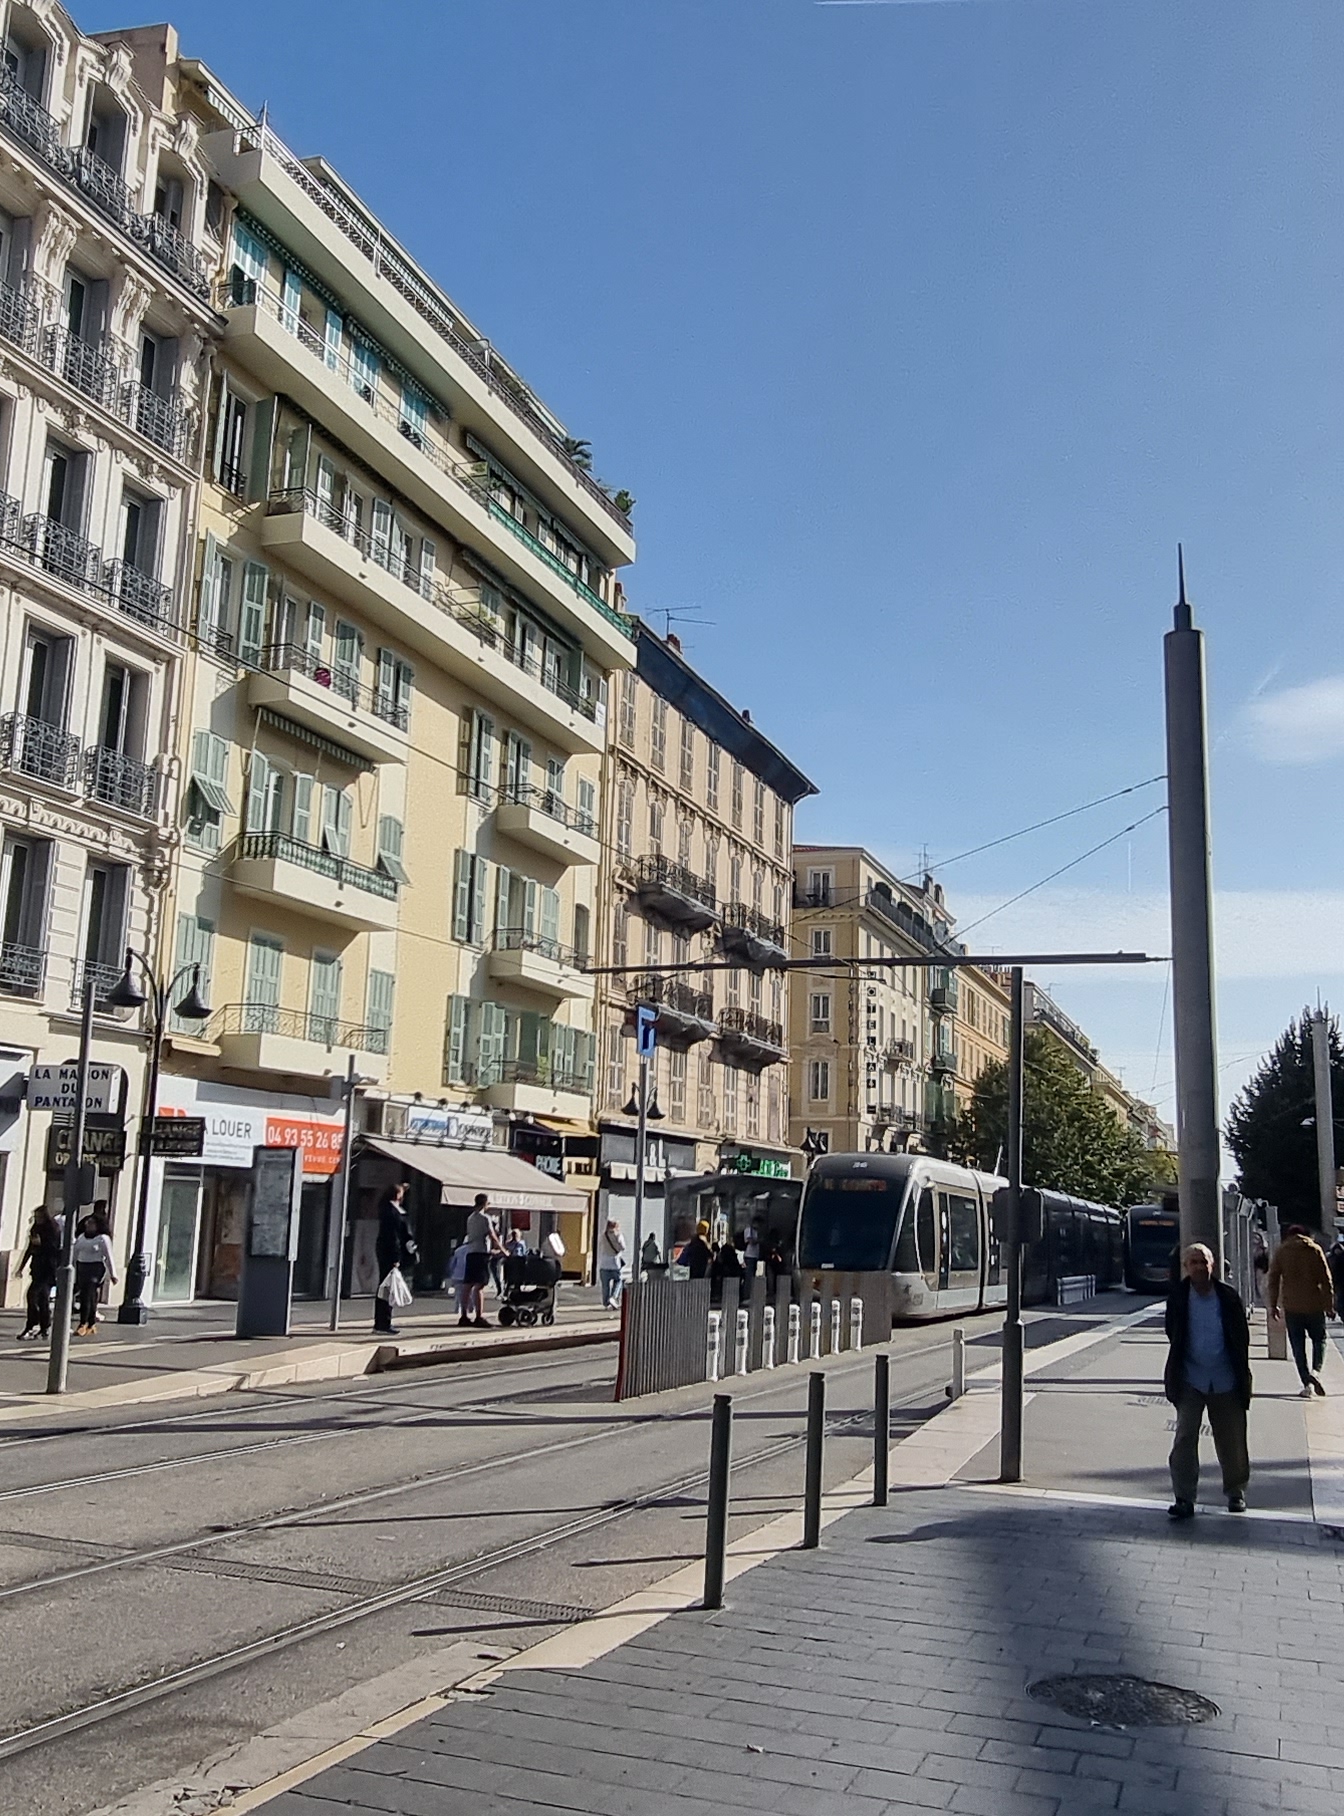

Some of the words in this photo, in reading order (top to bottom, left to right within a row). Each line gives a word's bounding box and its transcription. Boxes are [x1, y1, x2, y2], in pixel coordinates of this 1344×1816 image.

[35, 1069, 51, 1079] LA
[59, 1069, 109, 1080] MAON
[35, 1097, 102, 1108] PANTAON
[212, 1119, 252, 1139] LOUER
[268, 1126, 281, 1144] 04
[284, 1128, 299, 1146] 93
[300, 1130, 313, 1147] 55
[316, 1131, 328, 1148] 26
